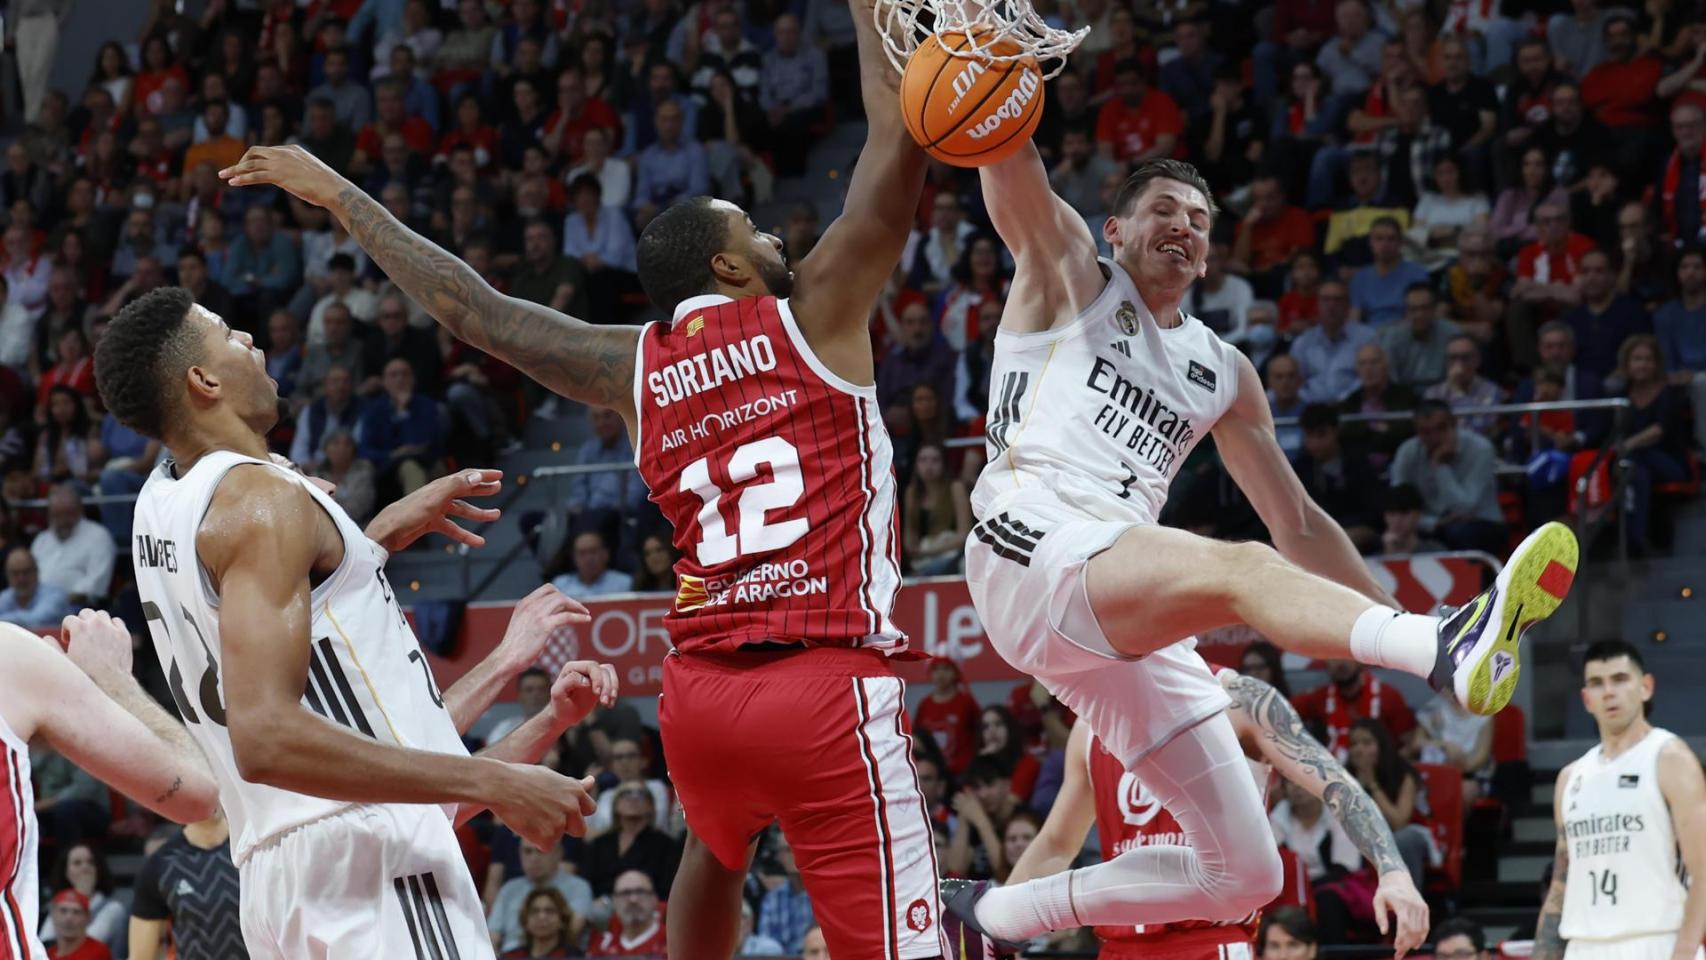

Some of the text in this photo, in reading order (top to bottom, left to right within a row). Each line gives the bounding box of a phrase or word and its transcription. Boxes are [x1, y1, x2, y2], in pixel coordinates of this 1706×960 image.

[966, 67, 1039, 139] Wilson
[647, 334, 778, 408] SORIANO
[1086, 356, 1195, 456] Emirate
[661, 389, 798, 452] AIR HORIZONT
[1093, 404, 1176, 478] FLY BETTER
[679, 436, 810, 567] 12
[735, 577, 828, 604] ARAGON
[1566, 813, 1645, 839] Emirates
[1589, 868, 1618, 907] 14
